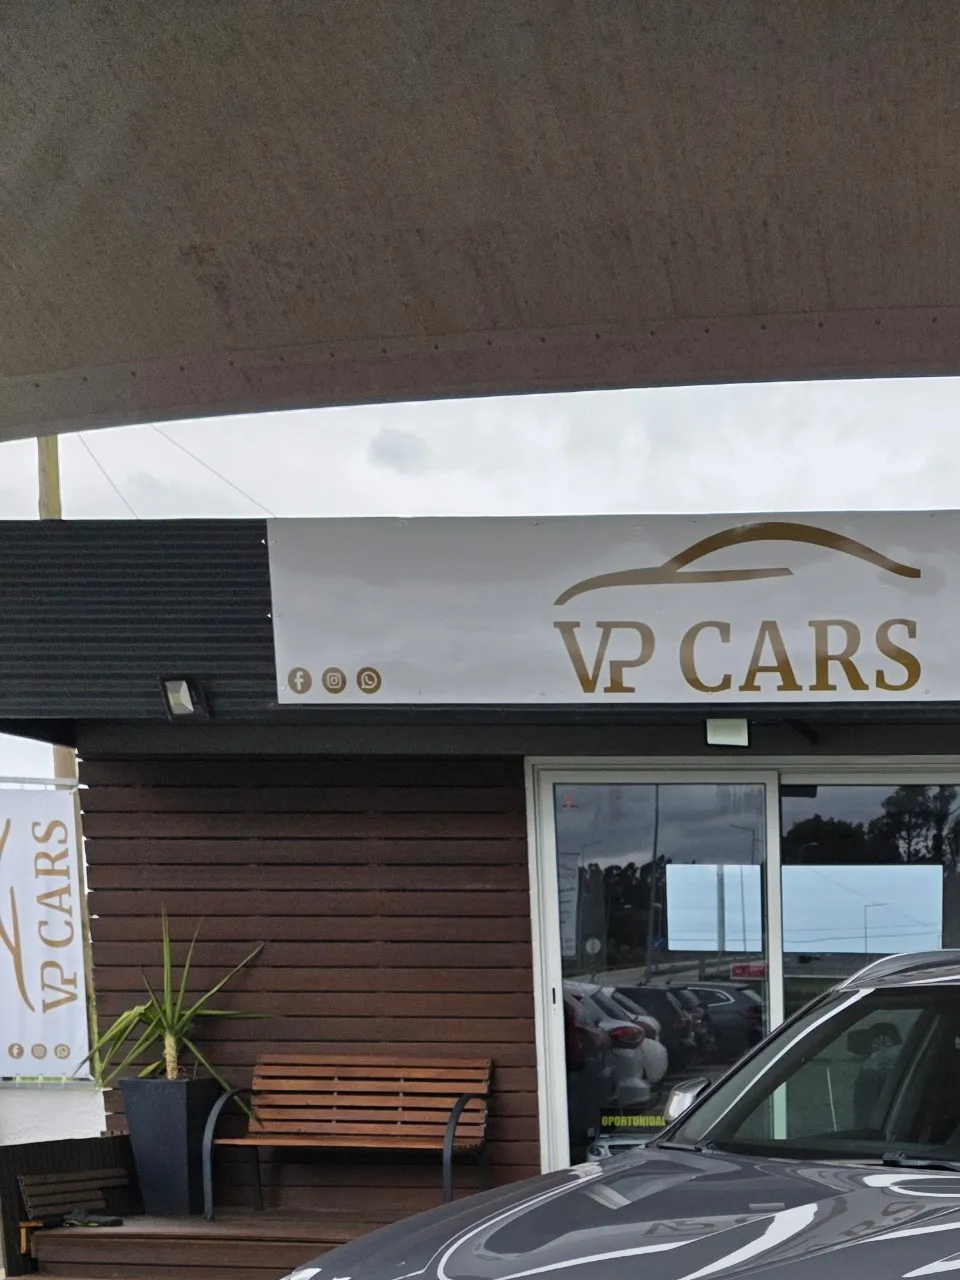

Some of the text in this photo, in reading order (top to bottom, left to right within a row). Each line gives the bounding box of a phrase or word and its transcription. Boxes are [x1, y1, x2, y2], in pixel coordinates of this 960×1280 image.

[553, 618, 922, 693] VP CARS
[31, 819, 78, 1014] VP CARS
